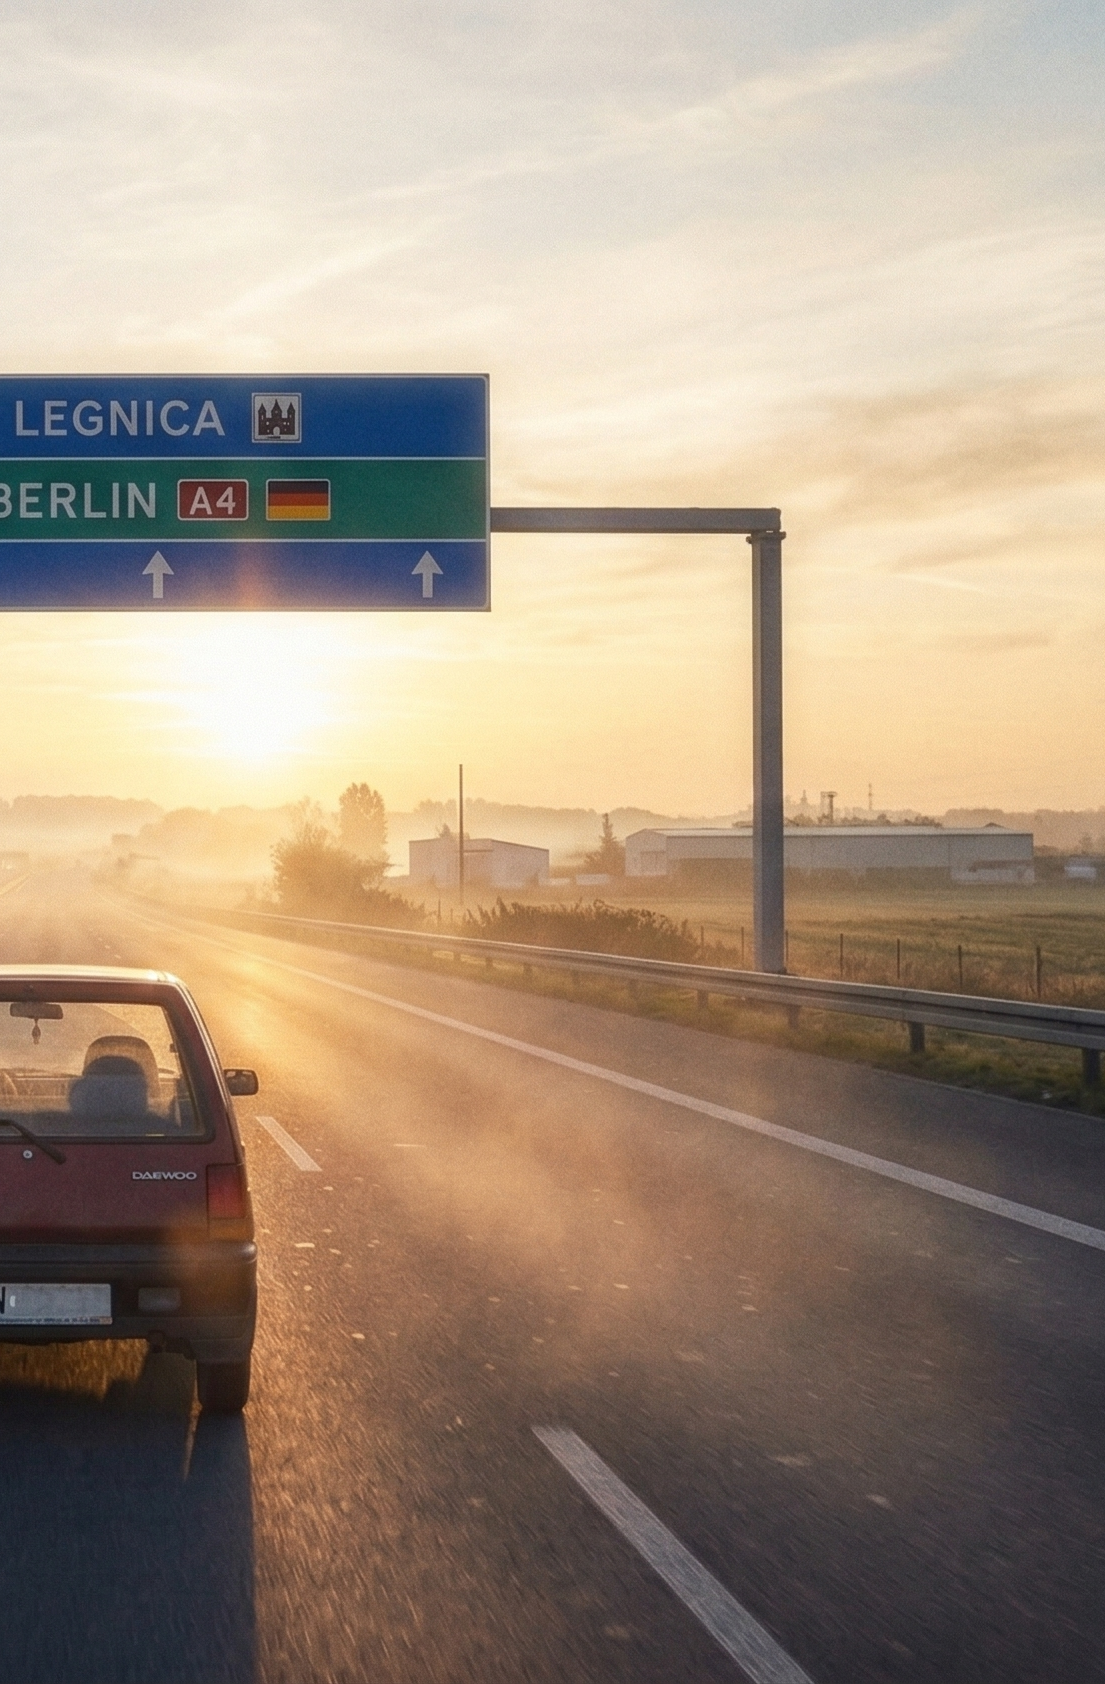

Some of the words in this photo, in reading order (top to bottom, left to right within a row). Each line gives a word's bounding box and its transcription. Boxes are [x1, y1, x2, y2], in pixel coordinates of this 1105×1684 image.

[15, 400, 226, 437] LEGNICA
[189, 486, 236, 515] A4
[132, 1171, 197, 1180] DAEWOO
